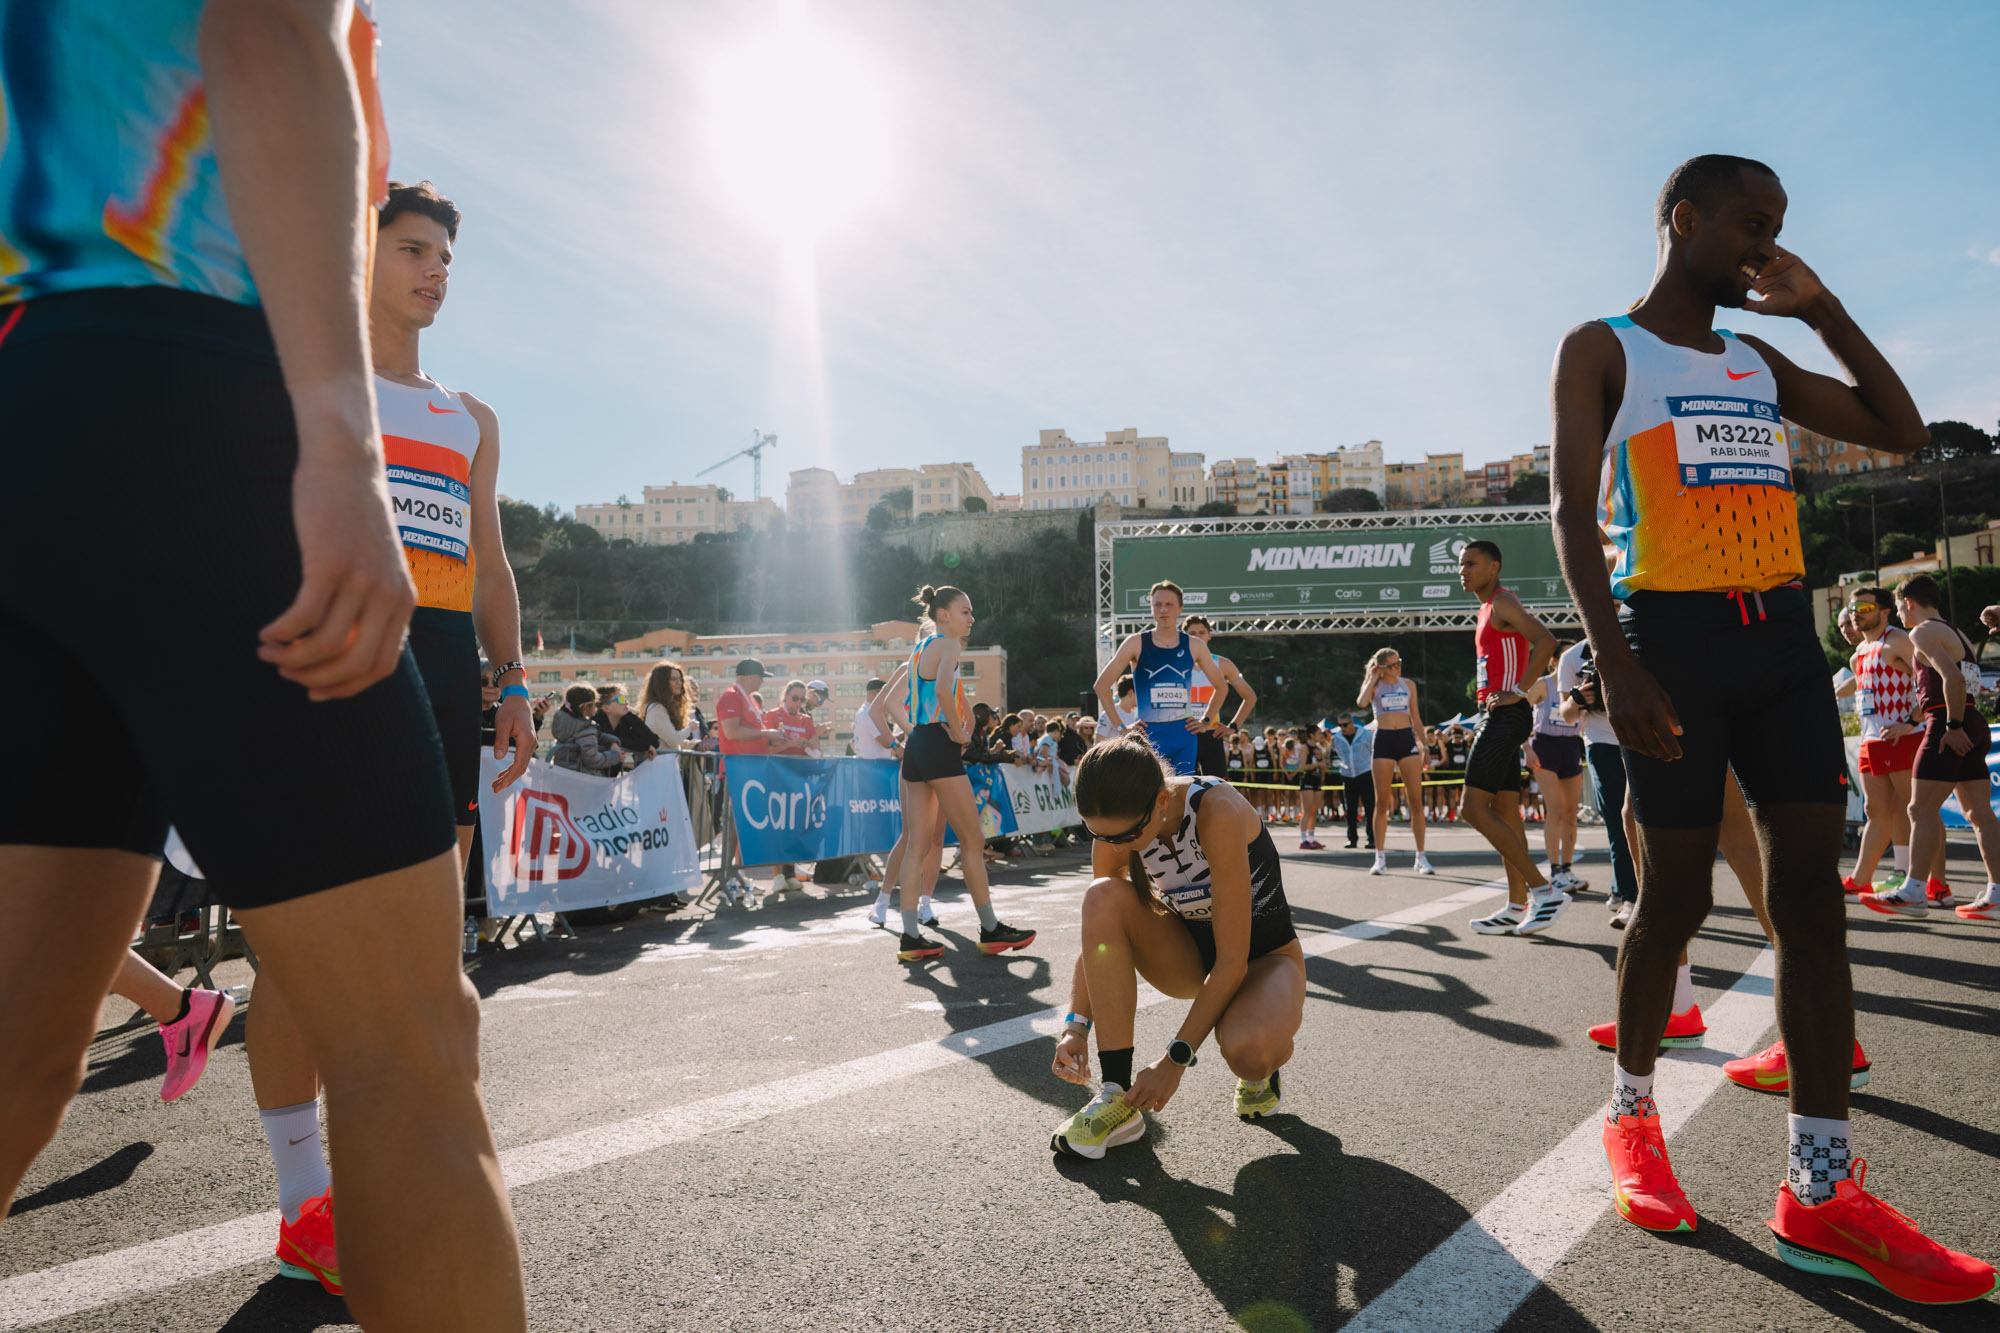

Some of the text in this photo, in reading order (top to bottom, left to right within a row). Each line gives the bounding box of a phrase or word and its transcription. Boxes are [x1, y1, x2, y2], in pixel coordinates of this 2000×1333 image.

[1681, 400, 1748, 413] MONACORUN
[1696, 424, 1773, 446] M3222
[1710, 447, 1770, 458] RABI DAHIR
[392, 496, 463, 528] M2053
[1247, 543, 1415, 571] MONACORUN
[1335, 589, 1363, 600] Carlo
[741, 779, 826, 830] Carlo
[850, 800, 877, 813] SHOP
[574, 803, 639, 833] radio
[591, 826, 669, 857] monaco
[1799, 1133, 1814, 1146] 23
[1830, 1136, 1847, 1149] 23
[1813, 1147, 1830, 1158] 23
[1811, 1170, 1829, 1183] 23
[1800, 1184, 1812, 1198] 23
